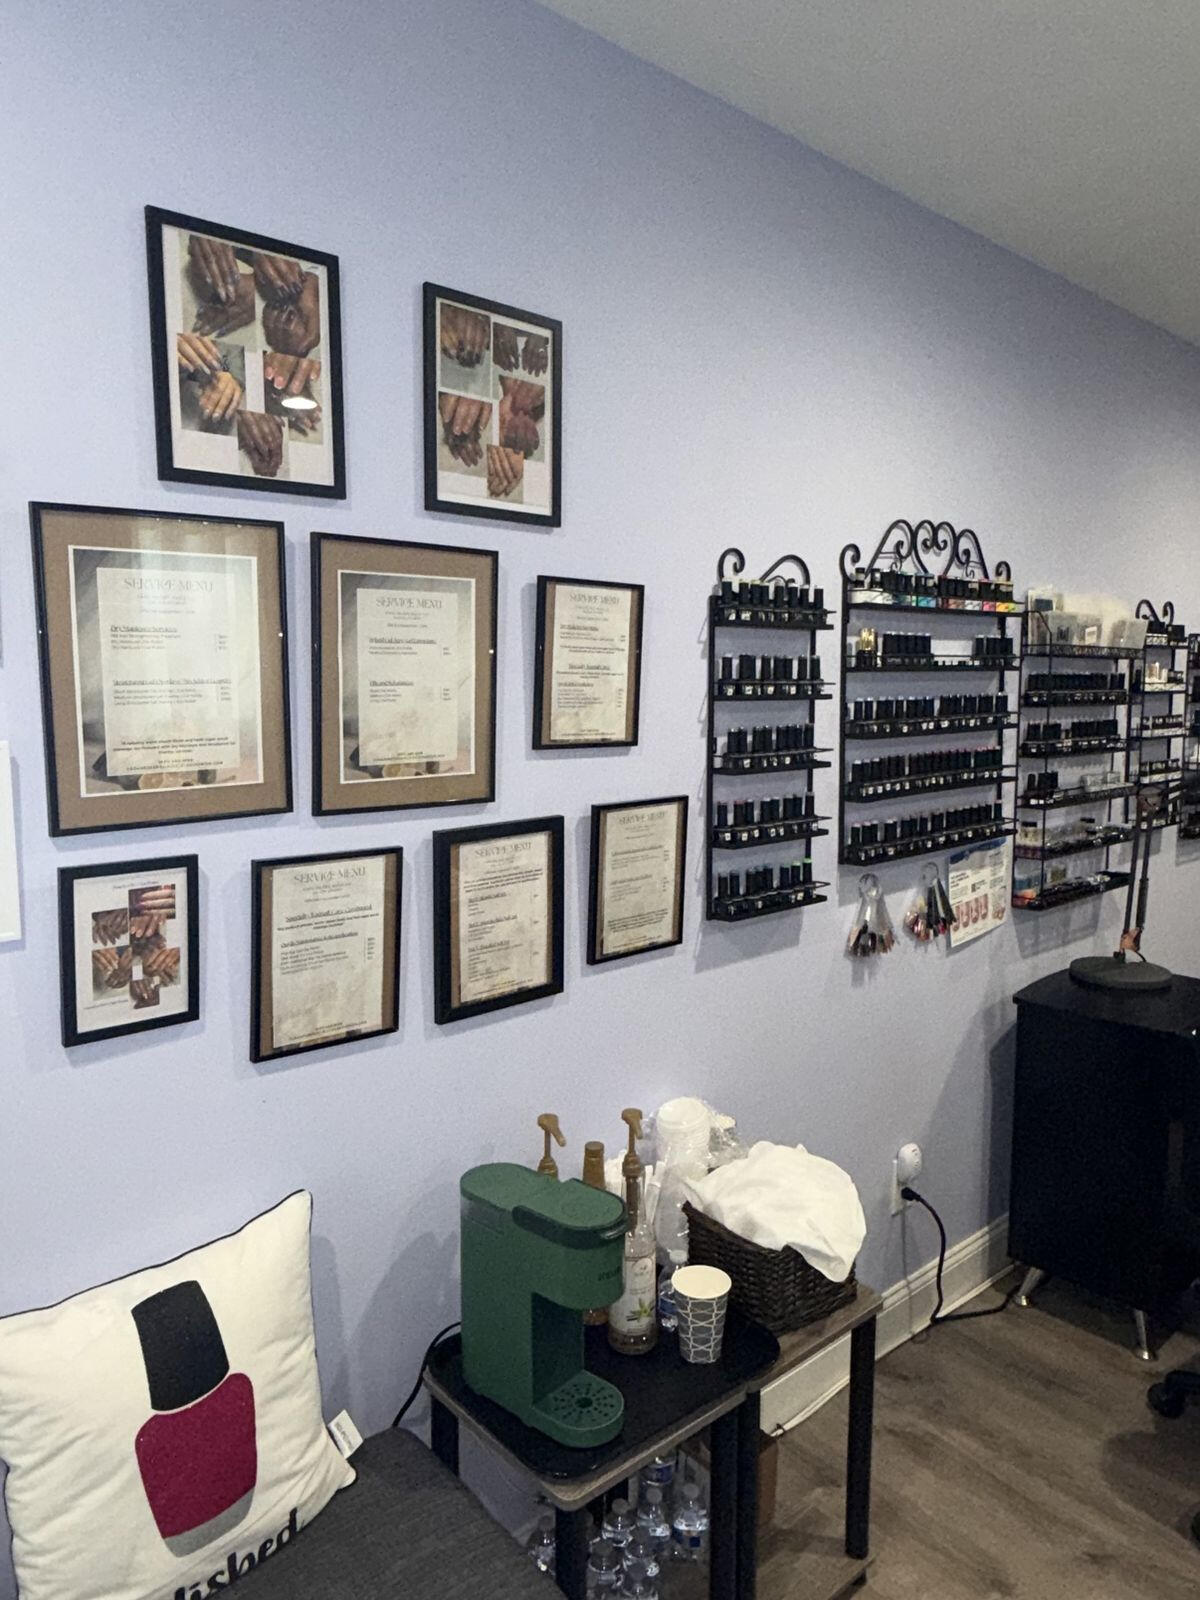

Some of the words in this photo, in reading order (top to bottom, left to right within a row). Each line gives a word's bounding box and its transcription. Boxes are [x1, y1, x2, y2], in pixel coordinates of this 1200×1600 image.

[416, 599, 443, 609] MENU
[293, 870, 334, 884] SERVICE
[337, 866, 366, 878] MENU
